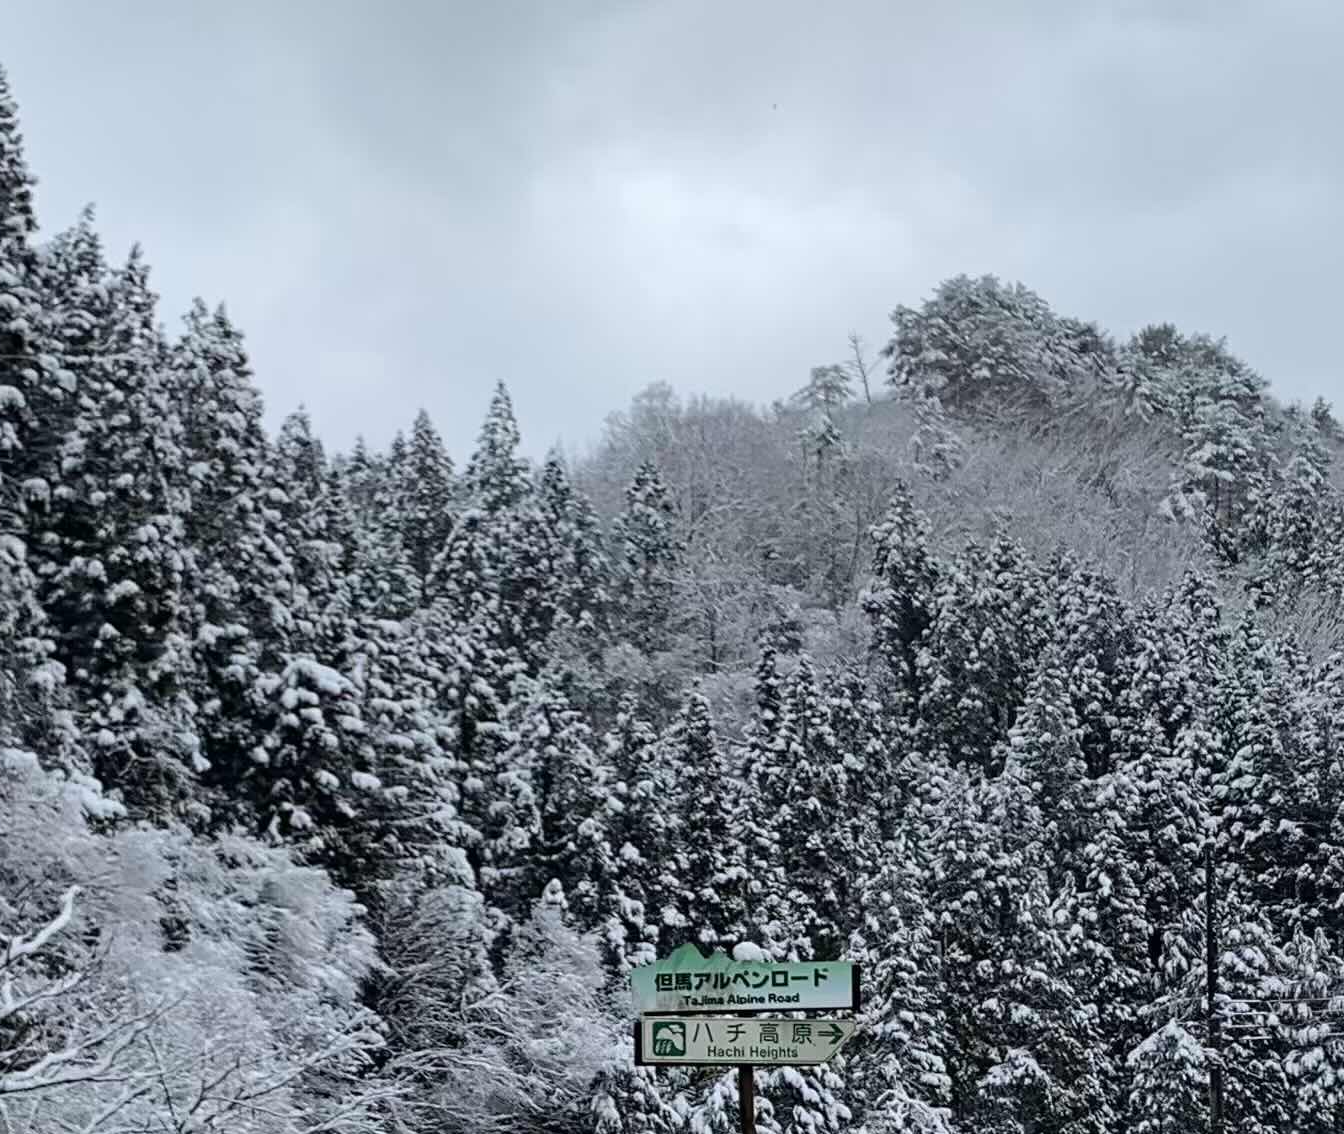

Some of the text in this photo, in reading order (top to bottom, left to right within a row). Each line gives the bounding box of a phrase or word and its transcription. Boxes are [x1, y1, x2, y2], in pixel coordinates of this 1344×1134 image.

[655, 968, 829, 992] 但馬アルペンロード
[683, 993, 800, 1007] Tajima Alpine Road
[692, 1022, 812, 1044] ハチ高原
[707, 1046, 798, 1059] Hachi Heights
